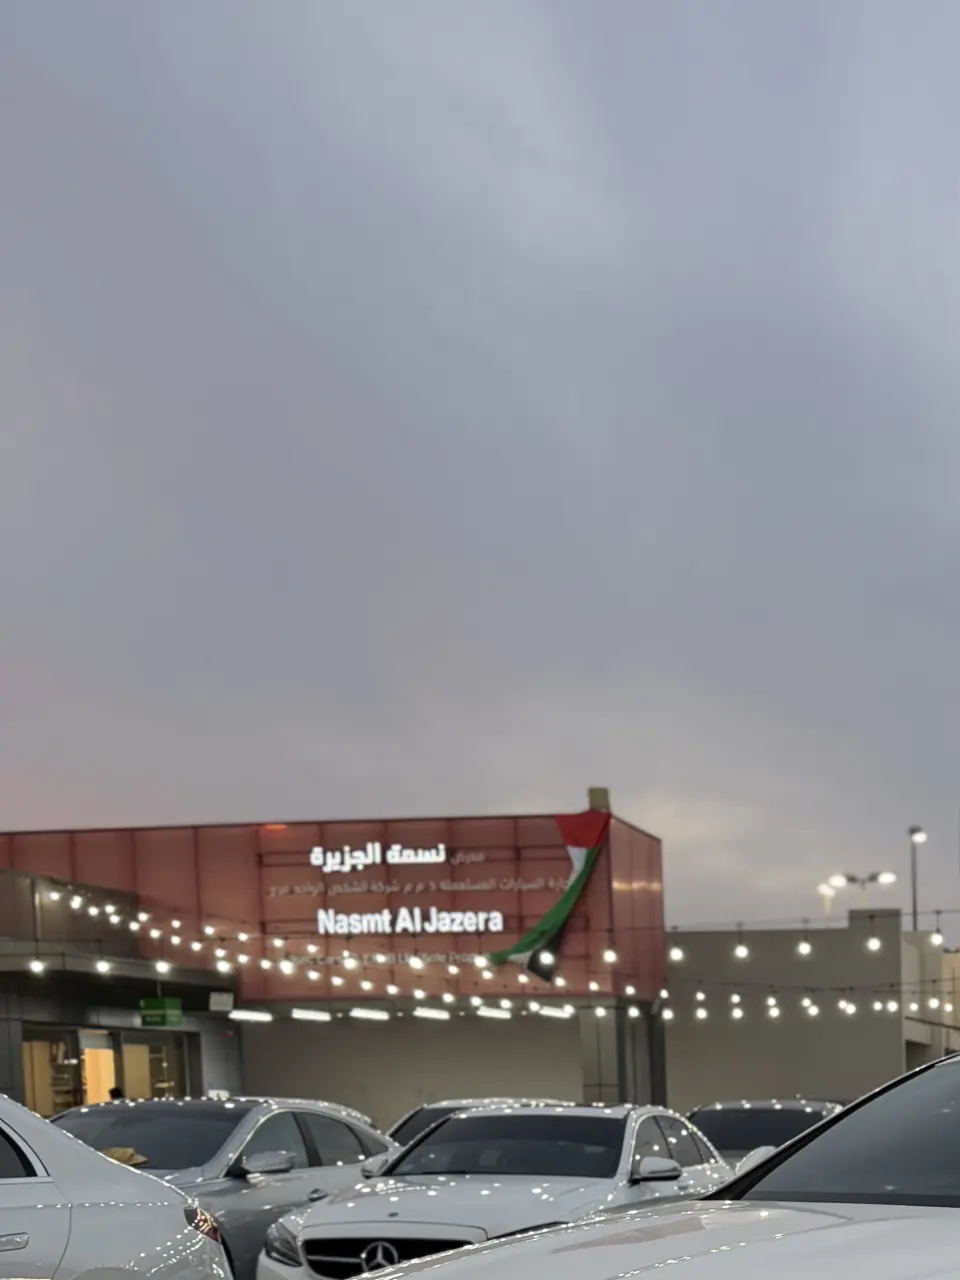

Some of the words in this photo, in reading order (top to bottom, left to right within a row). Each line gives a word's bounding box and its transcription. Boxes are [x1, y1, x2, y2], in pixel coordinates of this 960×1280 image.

[309, 842, 382, 873] الجزيرة
[386, 843, 446, 865] نسمة
[317, 908, 392, 934] Nasmt
[396, 906, 421, 933] Al
[424, 906, 504, 933] Jazera
